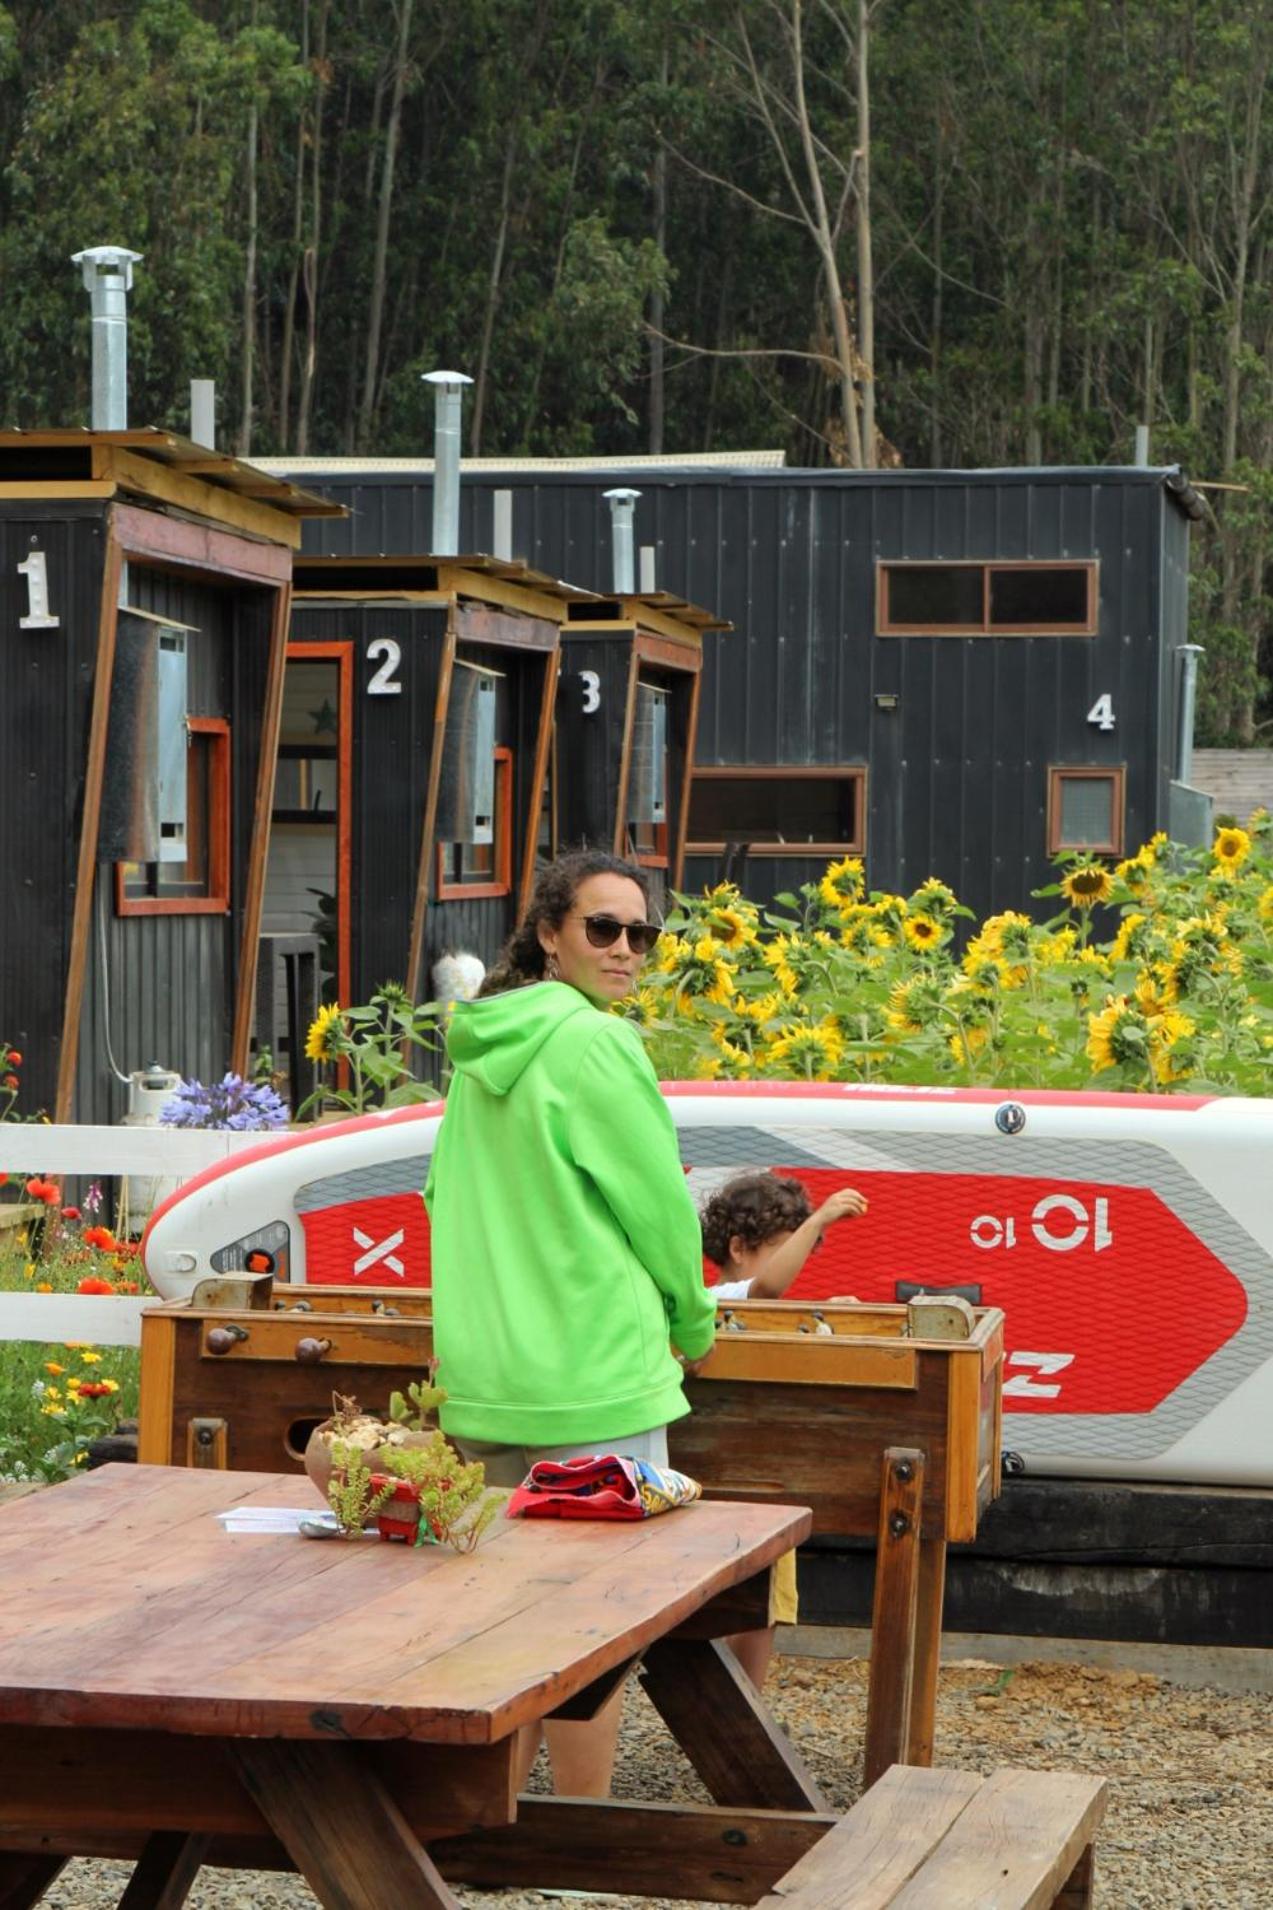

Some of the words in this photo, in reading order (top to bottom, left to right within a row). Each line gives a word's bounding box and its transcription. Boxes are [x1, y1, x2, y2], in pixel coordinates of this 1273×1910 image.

[17, 551, 60, 629] 1
[366, 639, 402, 694] 2
[579, 670, 601, 713] 3
[1087, 693, 1116, 730] 4
[1003, 1351, 1075, 1398] Z
